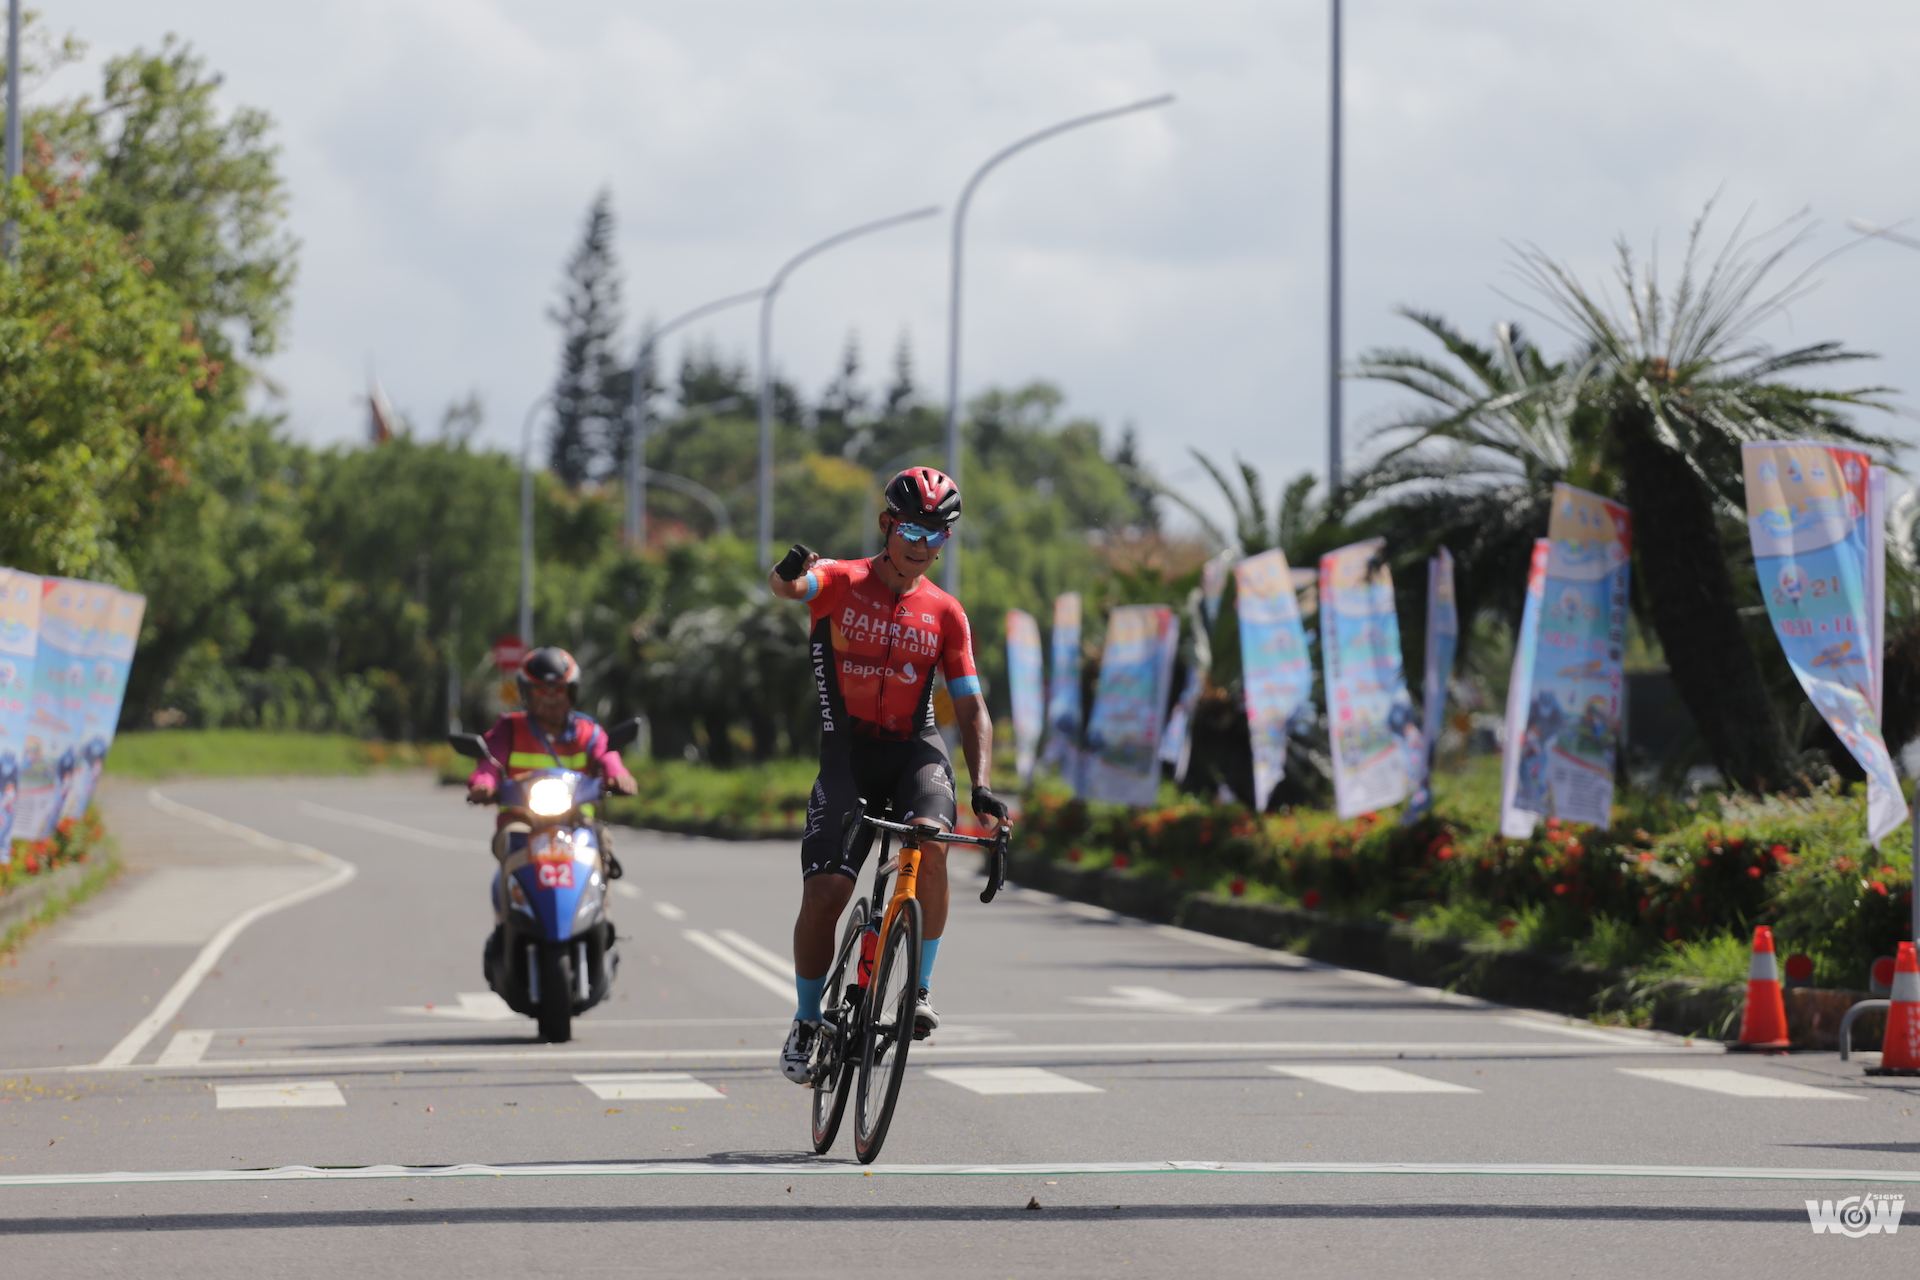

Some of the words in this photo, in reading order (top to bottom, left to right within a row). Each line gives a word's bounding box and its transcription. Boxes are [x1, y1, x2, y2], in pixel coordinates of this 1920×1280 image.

[840, 625, 937, 658] VICTORIOUS
[842, 607, 939, 649] BAHRAIN
[842, 660, 895, 678] Bapco
[812, 642, 835, 732] BAHRAIN
[539, 864, 574, 887] C2
